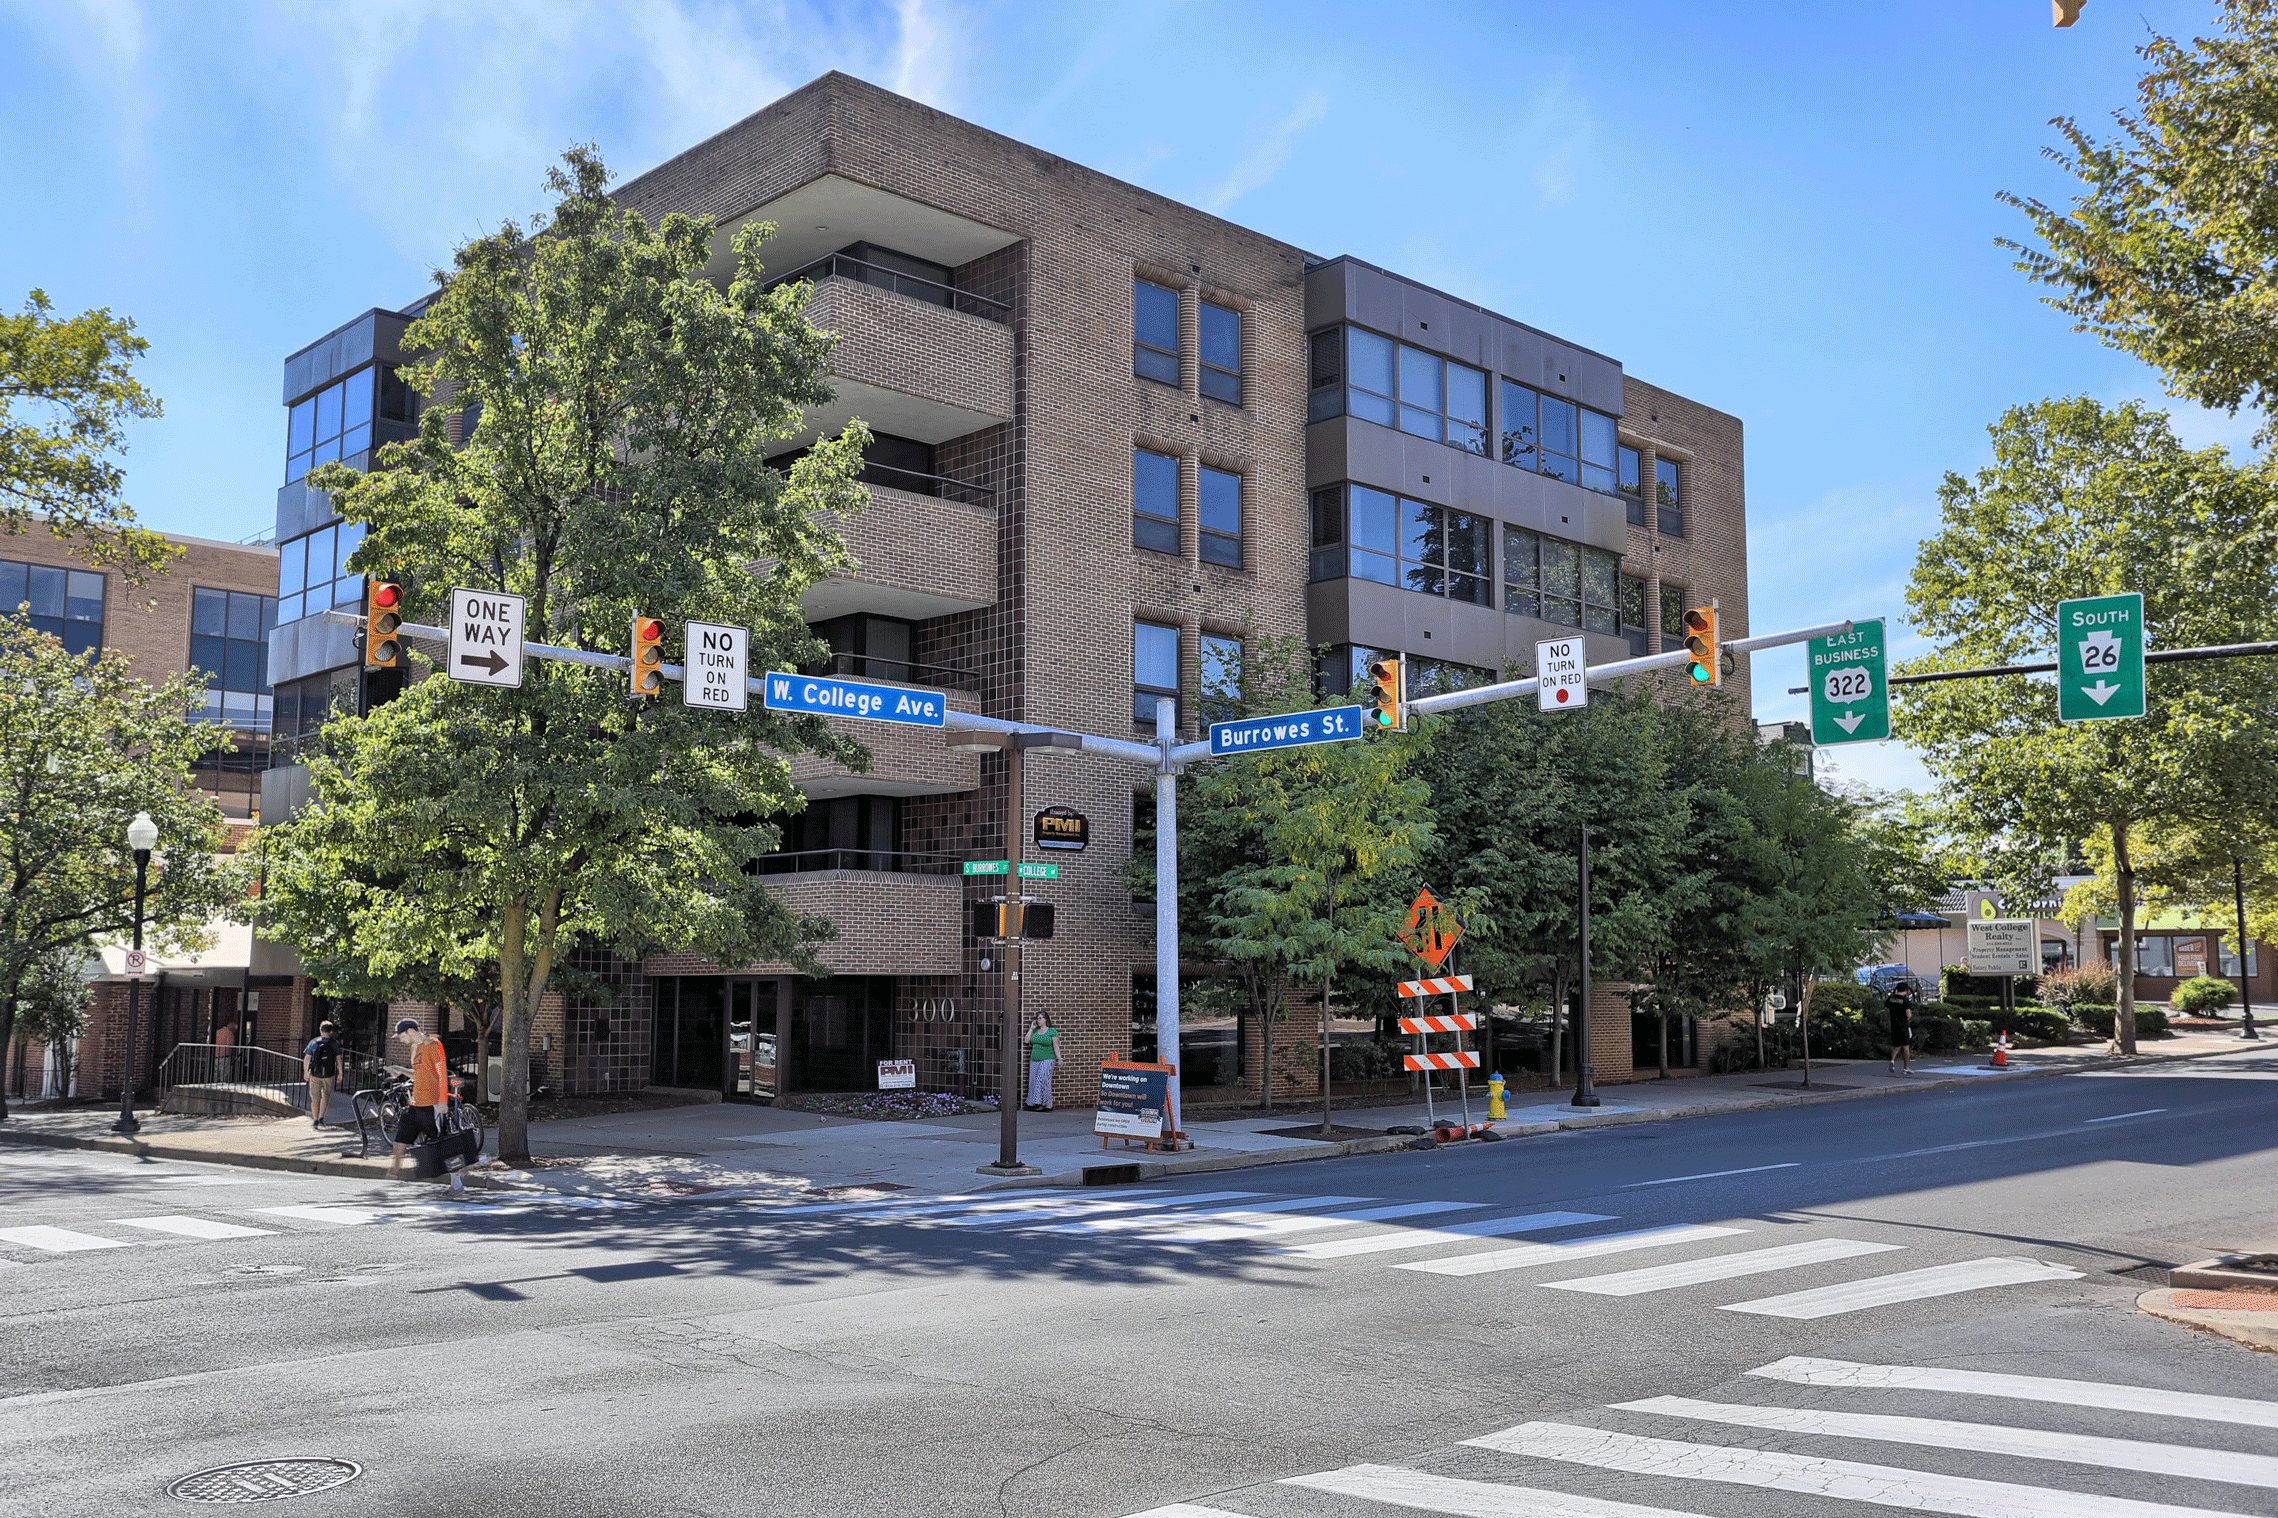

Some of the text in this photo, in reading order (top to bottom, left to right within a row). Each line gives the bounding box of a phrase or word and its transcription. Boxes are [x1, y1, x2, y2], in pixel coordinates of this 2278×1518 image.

[466, 598, 510, 623] ONE
[2072, 609, 2130, 627] SOUTH
[464, 622, 512, 646] WAY
[703, 630, 733, 652] NO
[1826, 631, 1865, 648] EAST
[1550, 643, 1570, 658] NO
[1814, 645, 1879, 666] BUSINESS
[2084, 644, 2118, 669] 26
[699, 652, 734, 670] TURN
[1547, 659, 1575, 673] TURN
[706, 671, 726, 685] ON
[1542, 673, 1581, 688] ON RED
[1828, 674, 1866, 698] 322
[703, 687, 730, 702] RED
[773, 679, 939, 718] W. College Ave.
[1221, 714, 1350, 748] Burrowes St.
[1042, 817, 1081, 833] PMI
[965, 863, 970, 873] S
[972, 862, 999, 873] BURROWES
[1023, 865, 1048, 877] COLLEGE
[1971, 923, 2029, 933] West College
[1985, 932, 2014, 941] Realty
[908, 997, 955, 1023] 300
[880, 1065, 914, 1076] PMI
[1101, 1081, 1130, 1090] Downtown
[1118, 1075, 1140, 1084] working
[1108, 1091, 1137, 1099] Downtown
